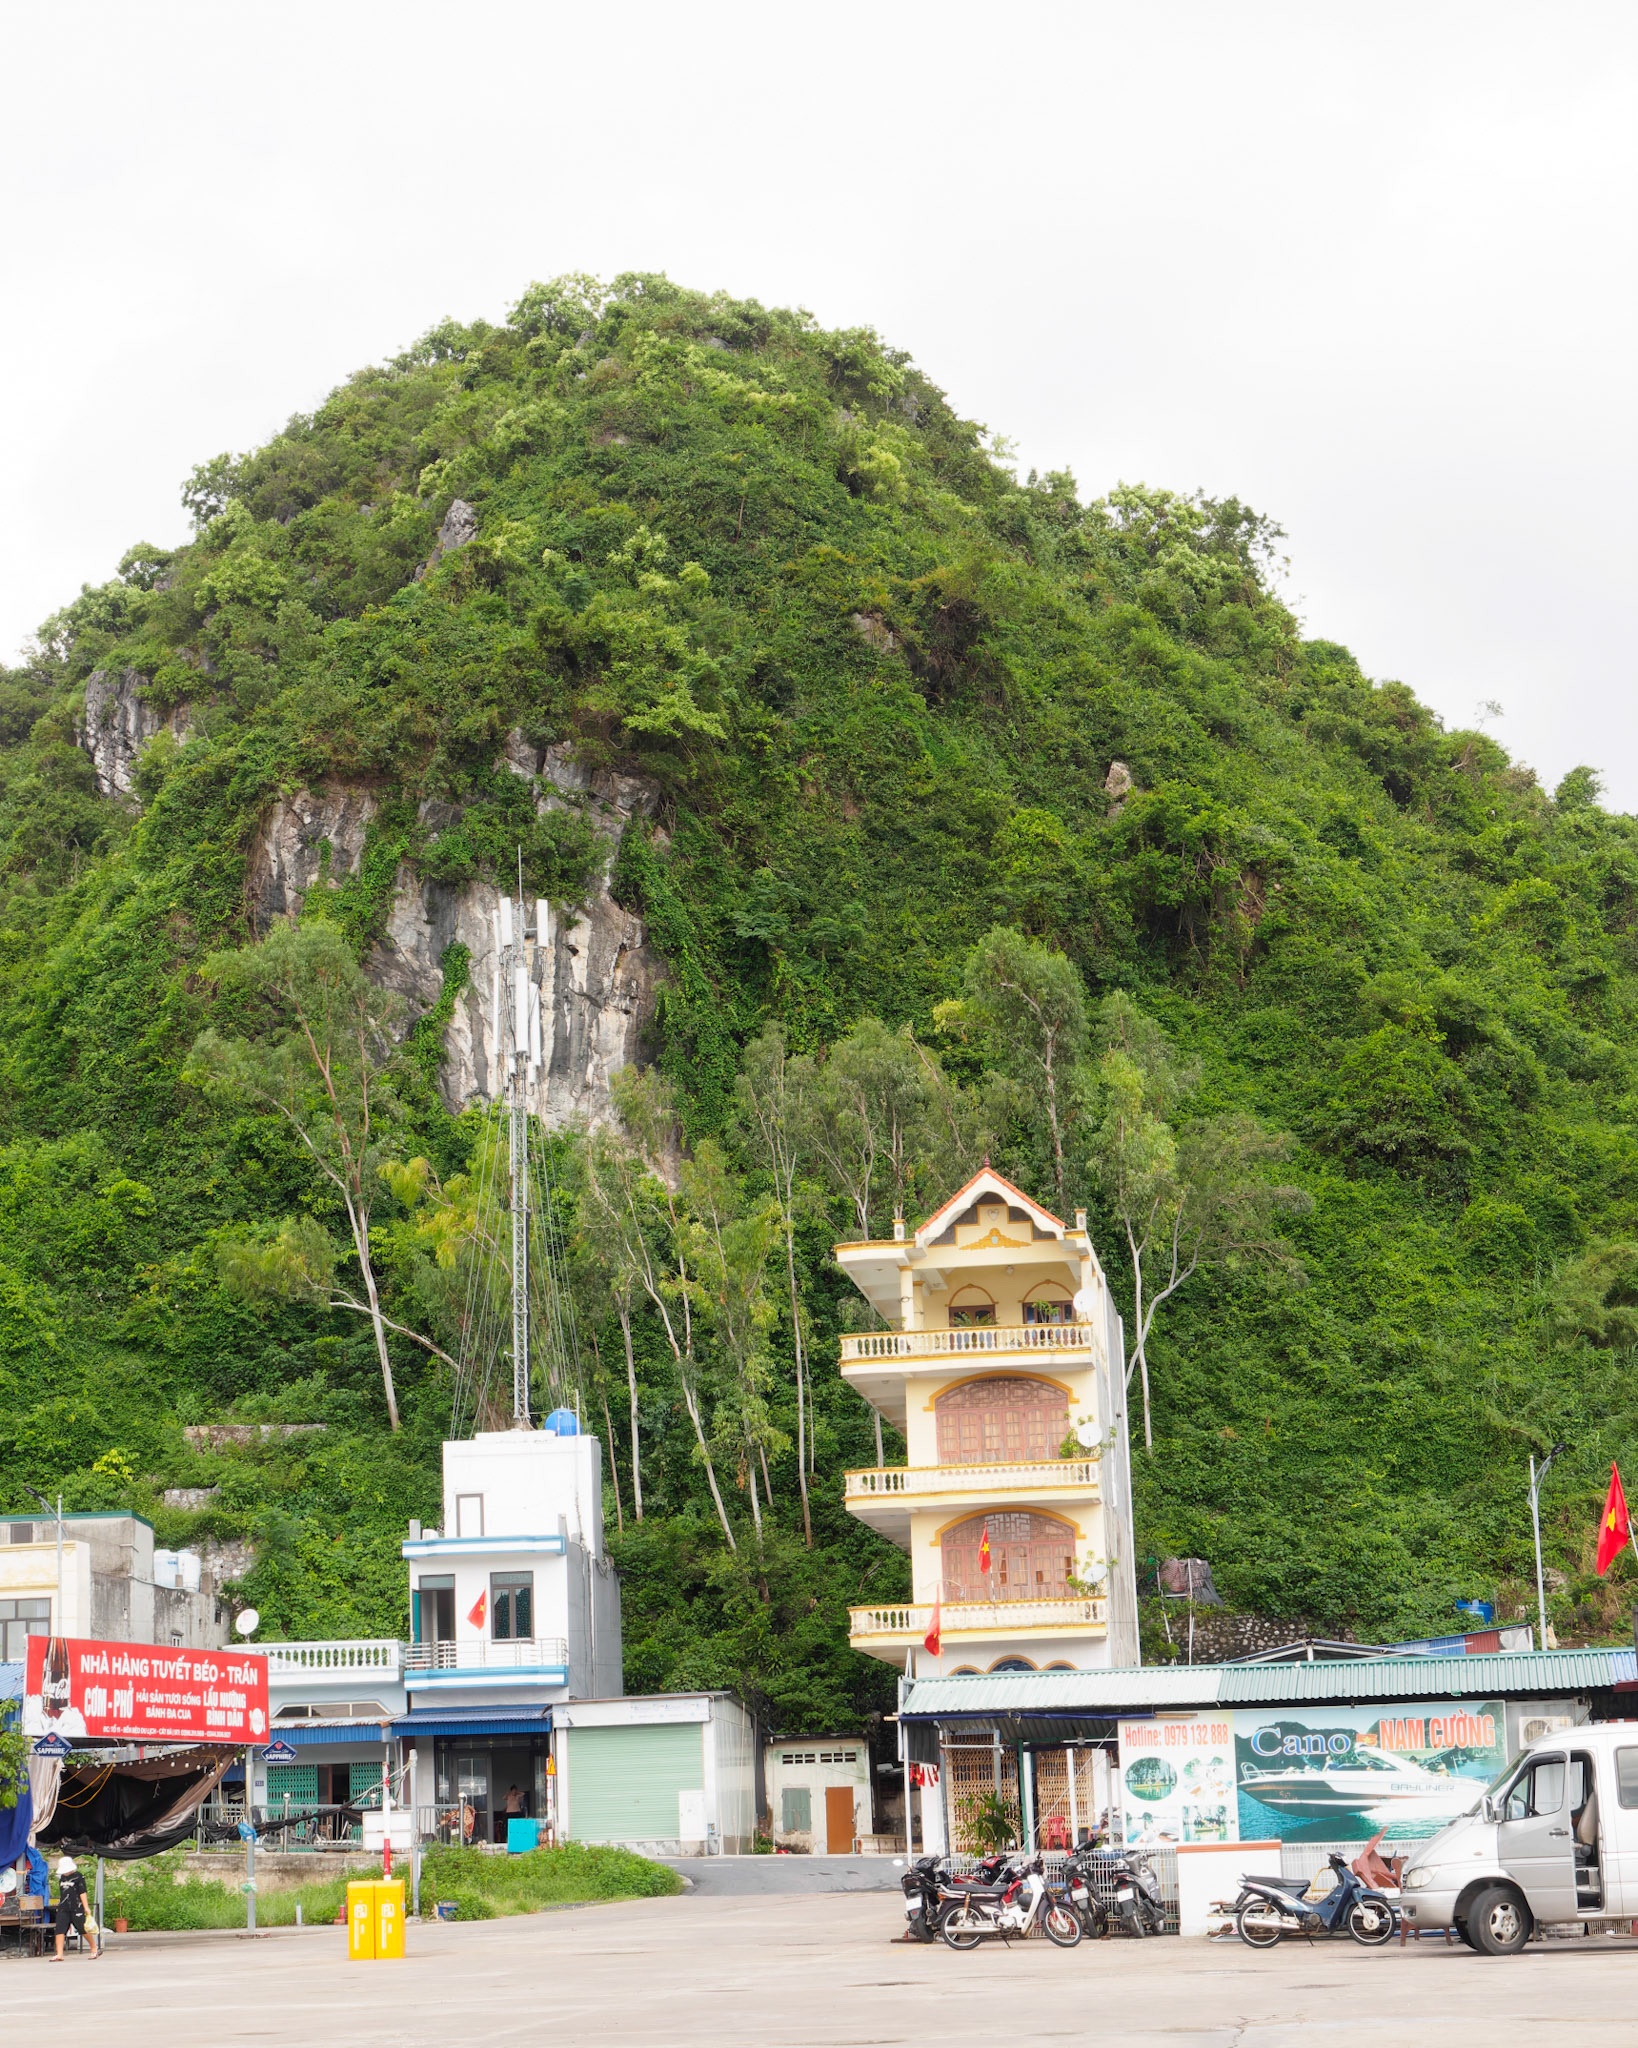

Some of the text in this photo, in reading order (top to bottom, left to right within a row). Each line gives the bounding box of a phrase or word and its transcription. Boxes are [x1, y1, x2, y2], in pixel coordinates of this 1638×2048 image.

[80, 1650, 109, 1674] NHÀ
[112, 1652, 149, 1677] HÀNG
[151, 1655, 192, 1681] TUYẾT
[193, 1659, 218, 1683] BÉO
[227, 1660, 258, 1686] TRẦN
[84, 1685, 107, 1718] CƠM
[113, 1680, 134, 1719] PHỞ
[136, 1688, 149, 1703] HẢI
[150, 1689, 164, 1704] SẢN
[146, 1705, 166, 1719] BÁNH
[177, 1709, 192, 1720] CUA
[1125, 1723, 1229, 1747] Hotline: 0979 132 888
[1251, 1709, 1497, 1757] Cano NAM CƯỜNG
[37, 1747, 66, 1755] SAPPHIRE
[1390, 1783, 1455, 1792] BAYLINER
